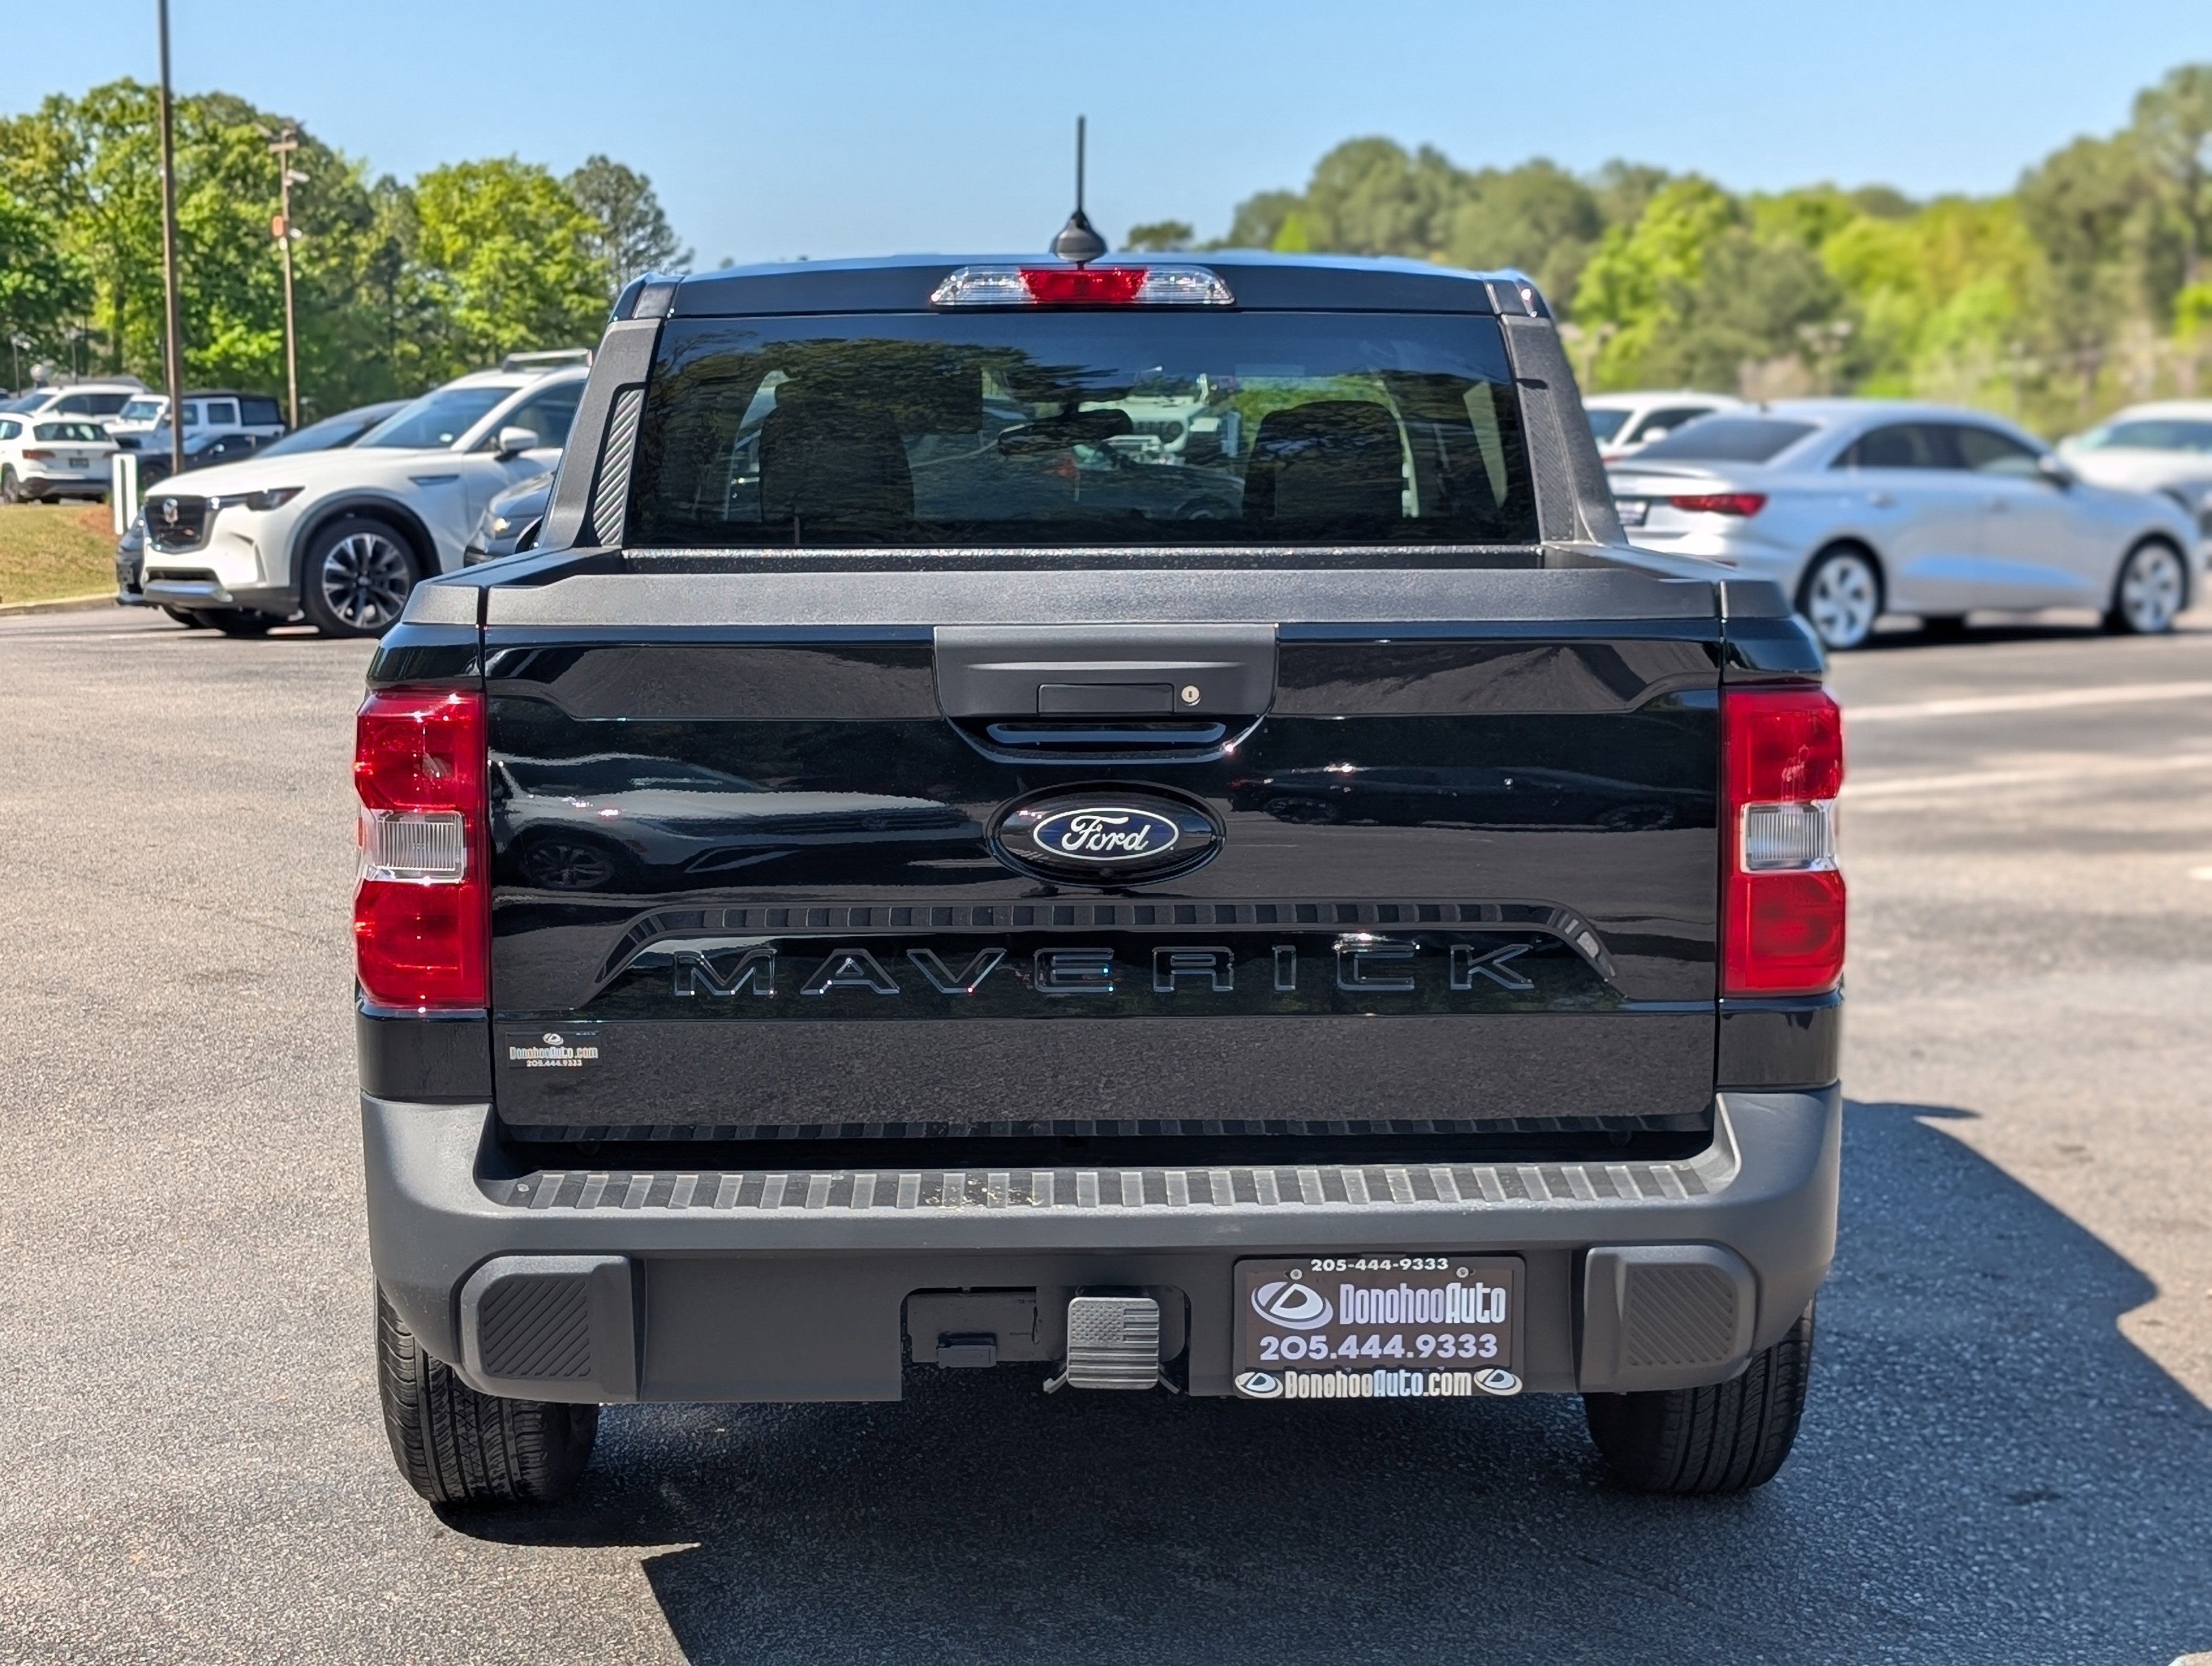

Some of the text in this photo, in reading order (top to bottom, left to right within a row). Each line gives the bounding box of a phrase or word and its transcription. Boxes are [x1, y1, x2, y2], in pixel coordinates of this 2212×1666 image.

[1061, 815, 1152, 851] Ford
[673, 945, 1535, 997] MAVERICK
[1310, 1258, 1449, 1272] 205-444-9333
[1339, 1282, 1506, 1325] DonohooAuto
[1259, 1333, 1497, 1361] 205.444.9333
[1284, 1369, 1472, 1398] DonohooAuto.com
